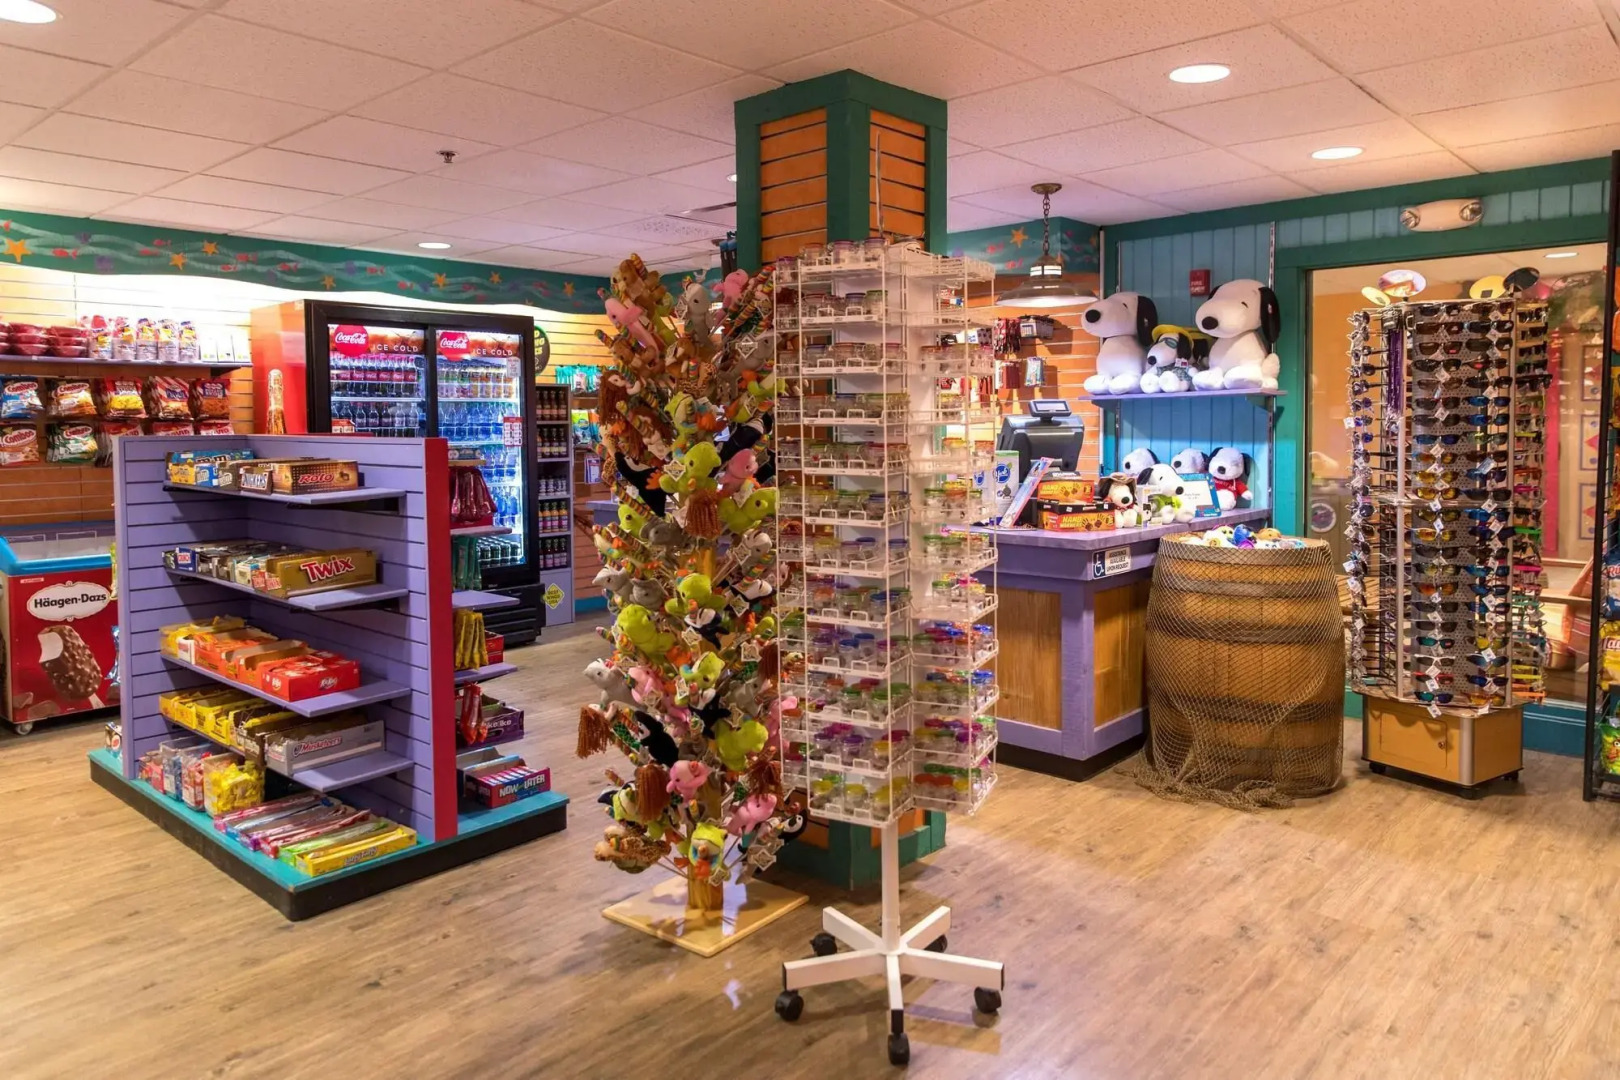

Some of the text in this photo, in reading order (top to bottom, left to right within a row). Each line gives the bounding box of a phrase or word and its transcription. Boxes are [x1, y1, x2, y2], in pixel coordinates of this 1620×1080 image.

[4, 430, 36, 444] Combos
[34, 594, 107, 608] Häagen-Dazs
[499, 784, 519, 797] NOW
[524, 774, 546, 788] LATER
